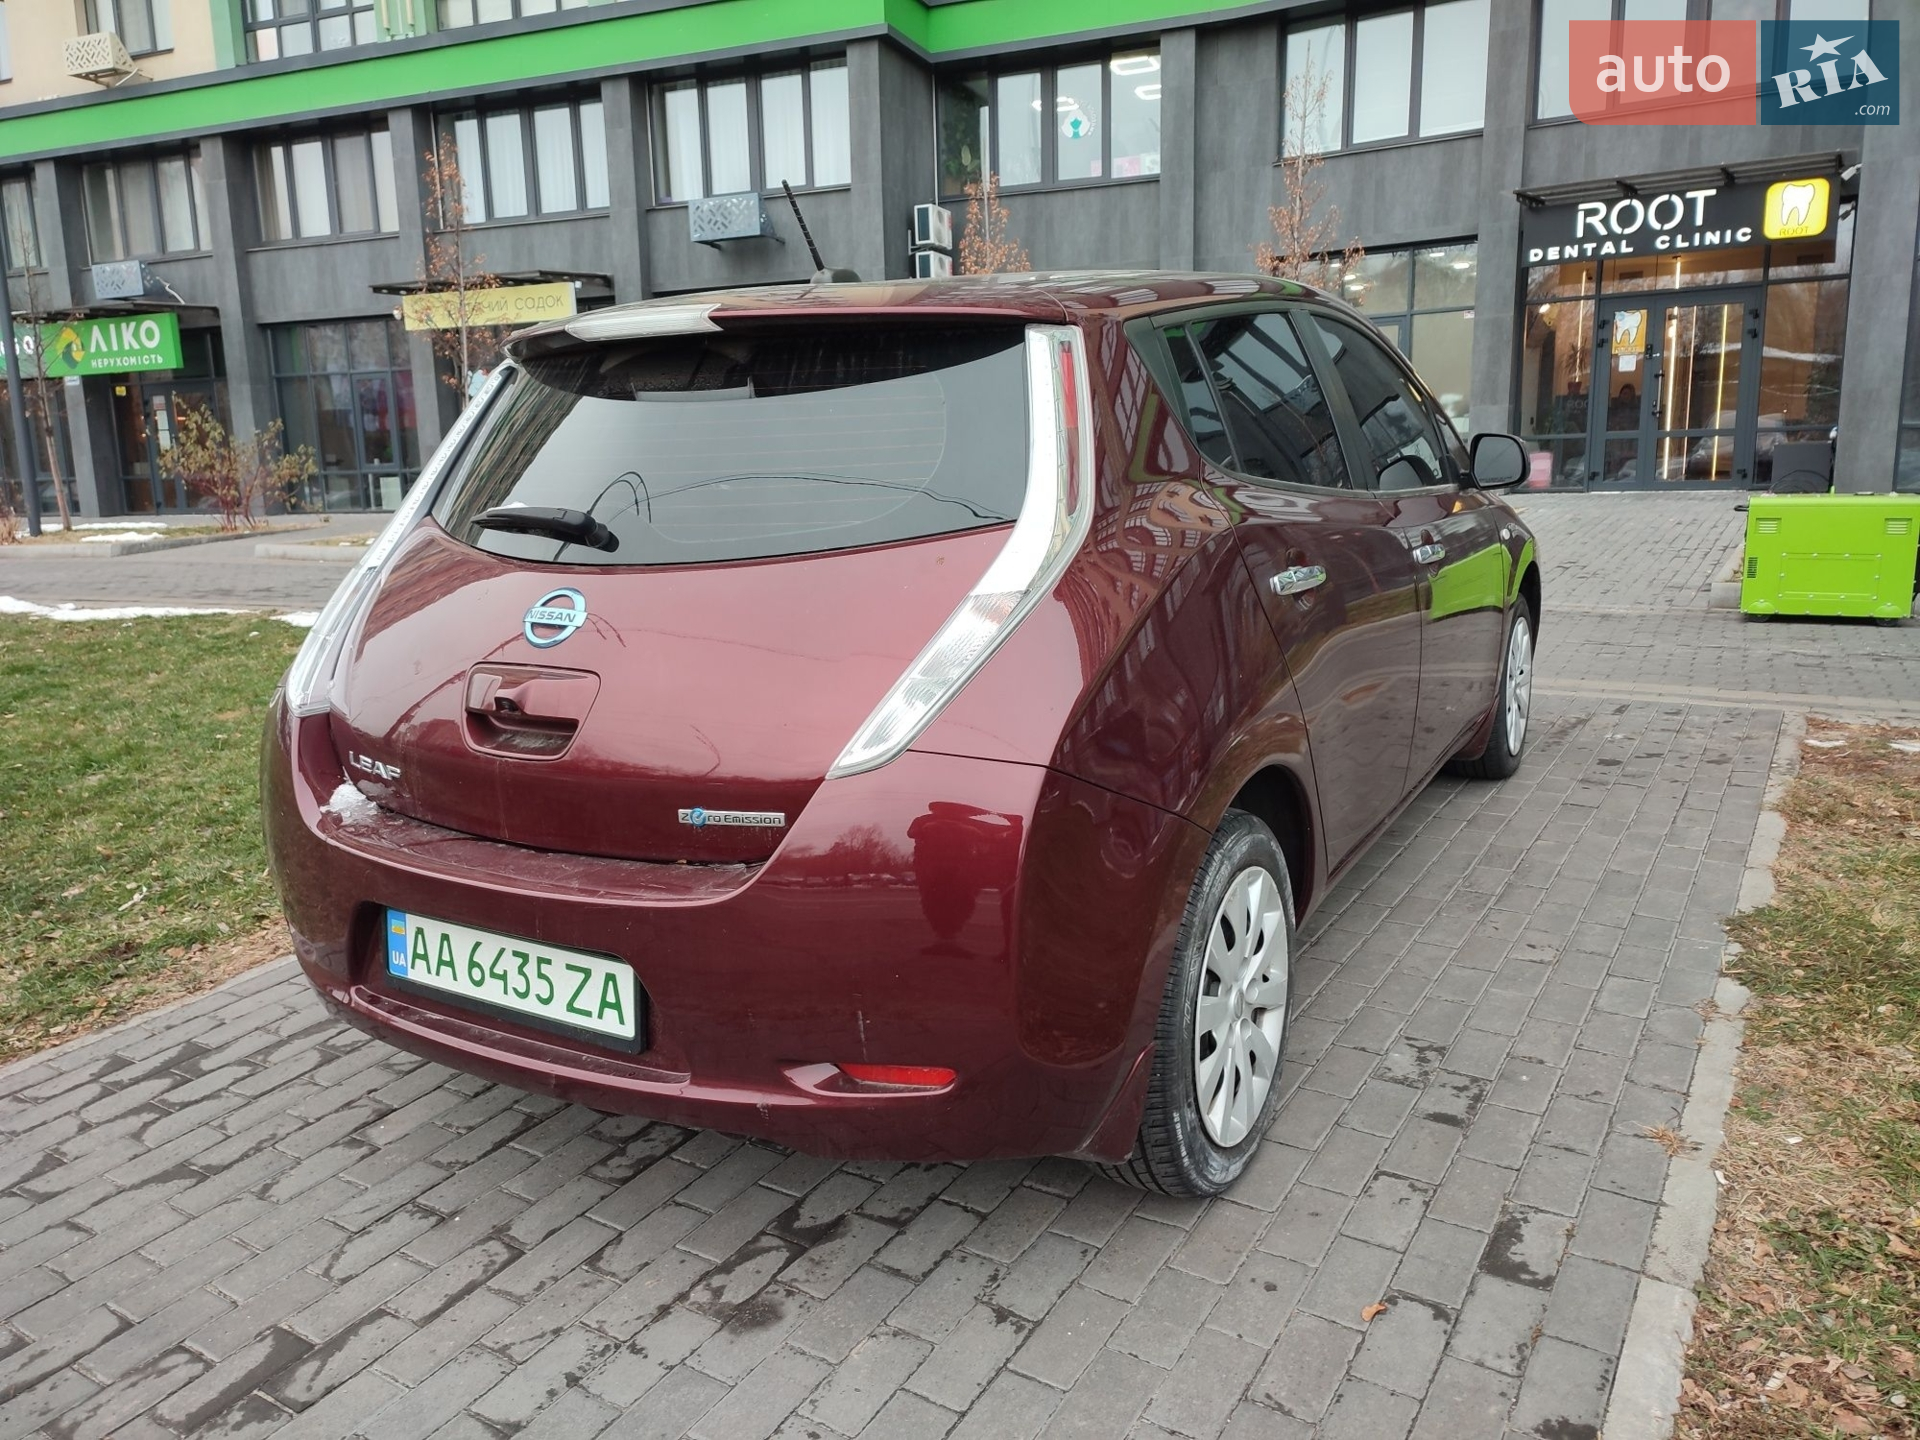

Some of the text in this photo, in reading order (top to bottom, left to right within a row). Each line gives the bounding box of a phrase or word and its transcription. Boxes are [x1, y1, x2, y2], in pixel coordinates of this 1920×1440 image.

[1576, 188, 1717, 238] ROOT
[1779, 226, 1809, 236] ROOT
[1529, 227, 1753, 263] DENTAL CLINIC
[90, 319, 161, 353] ЛІКО
[91, 354, 164, 368] НЕРУХОМІСТЬ
[526, 609, 577, 623] NISSAN
[349, 750, 401, 781] LEAF
[724, 814, 782, 825] Emission
[392, 950, 407, 967] UA
[410, 926, 626, 1026] AA 6435 ZA
